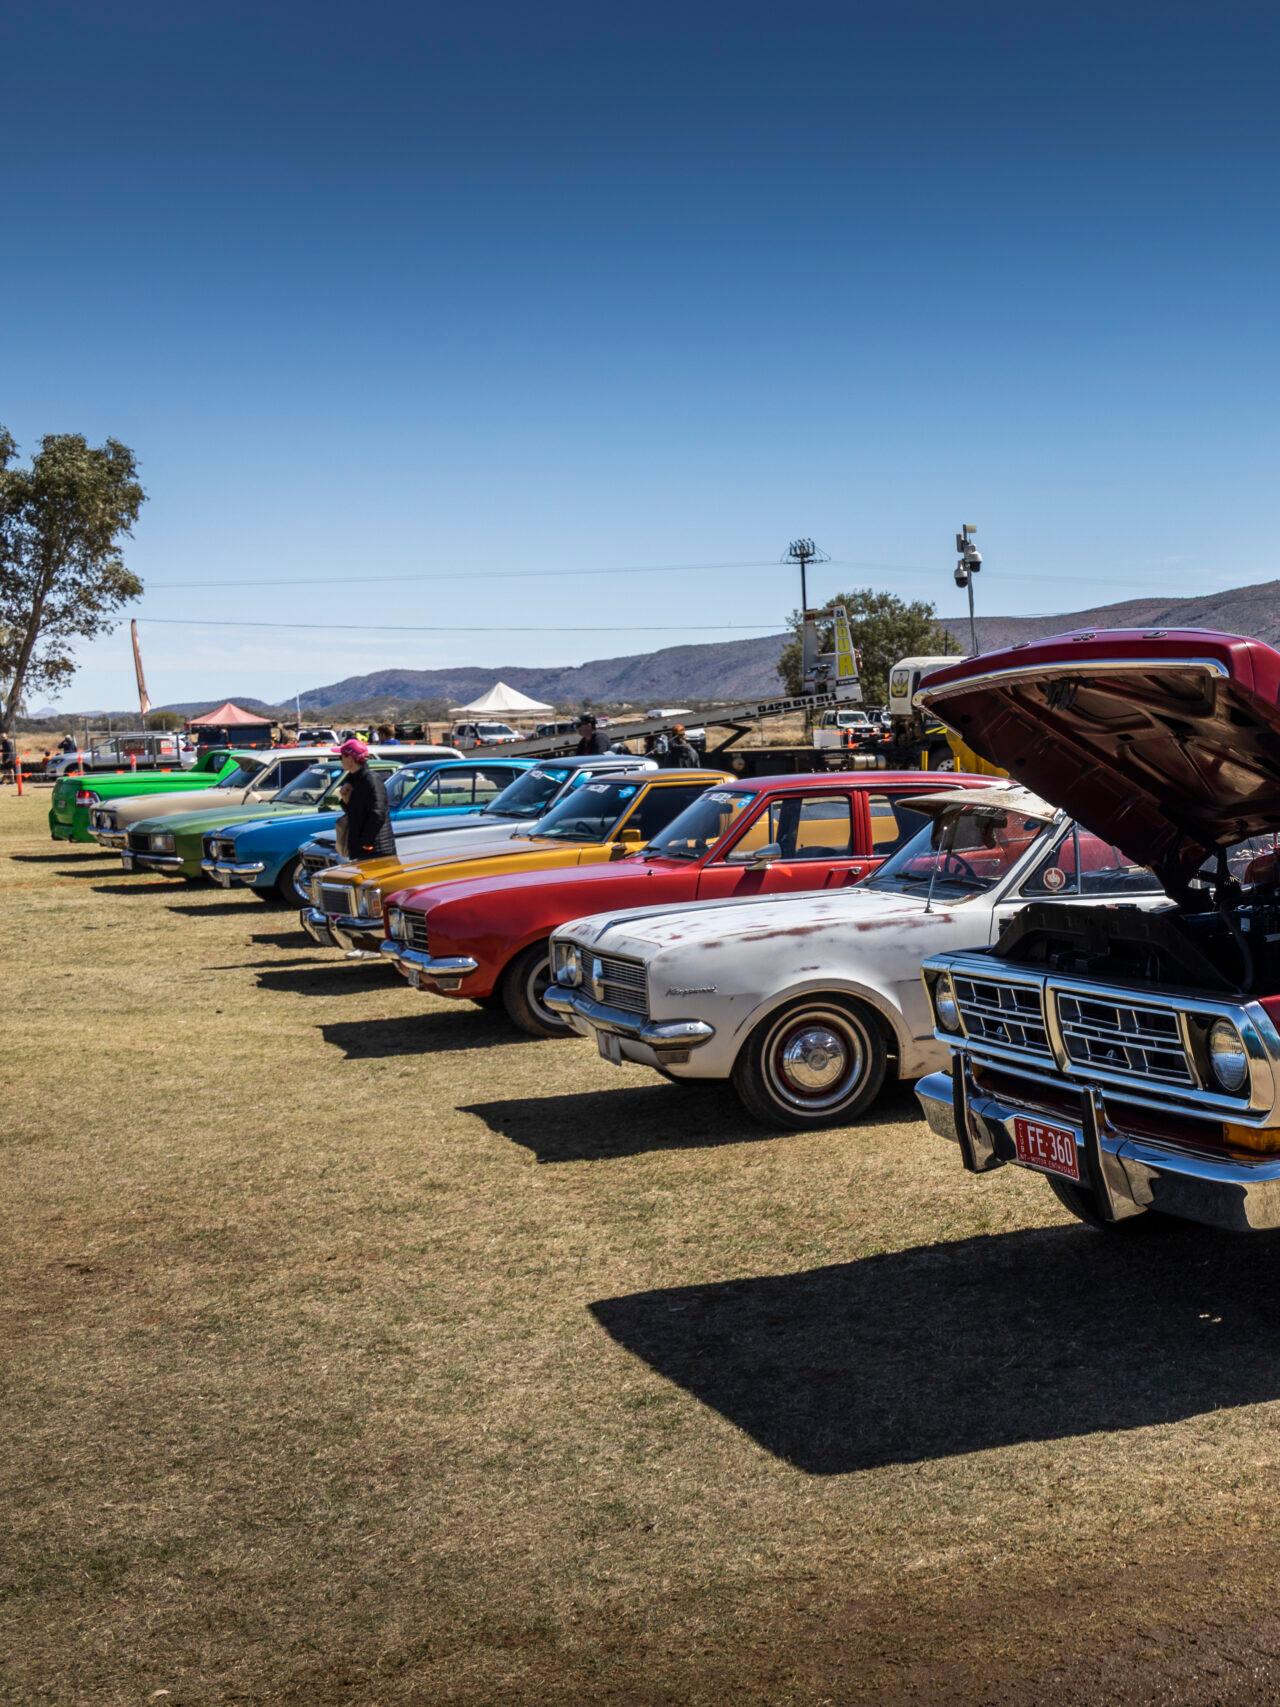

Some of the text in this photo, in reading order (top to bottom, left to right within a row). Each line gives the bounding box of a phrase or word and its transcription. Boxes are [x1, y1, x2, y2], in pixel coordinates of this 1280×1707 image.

[836, 609, 844, 618] 24
[836, 618, 856, 677] HOUR
[757, 700, 792, 712] 0428
